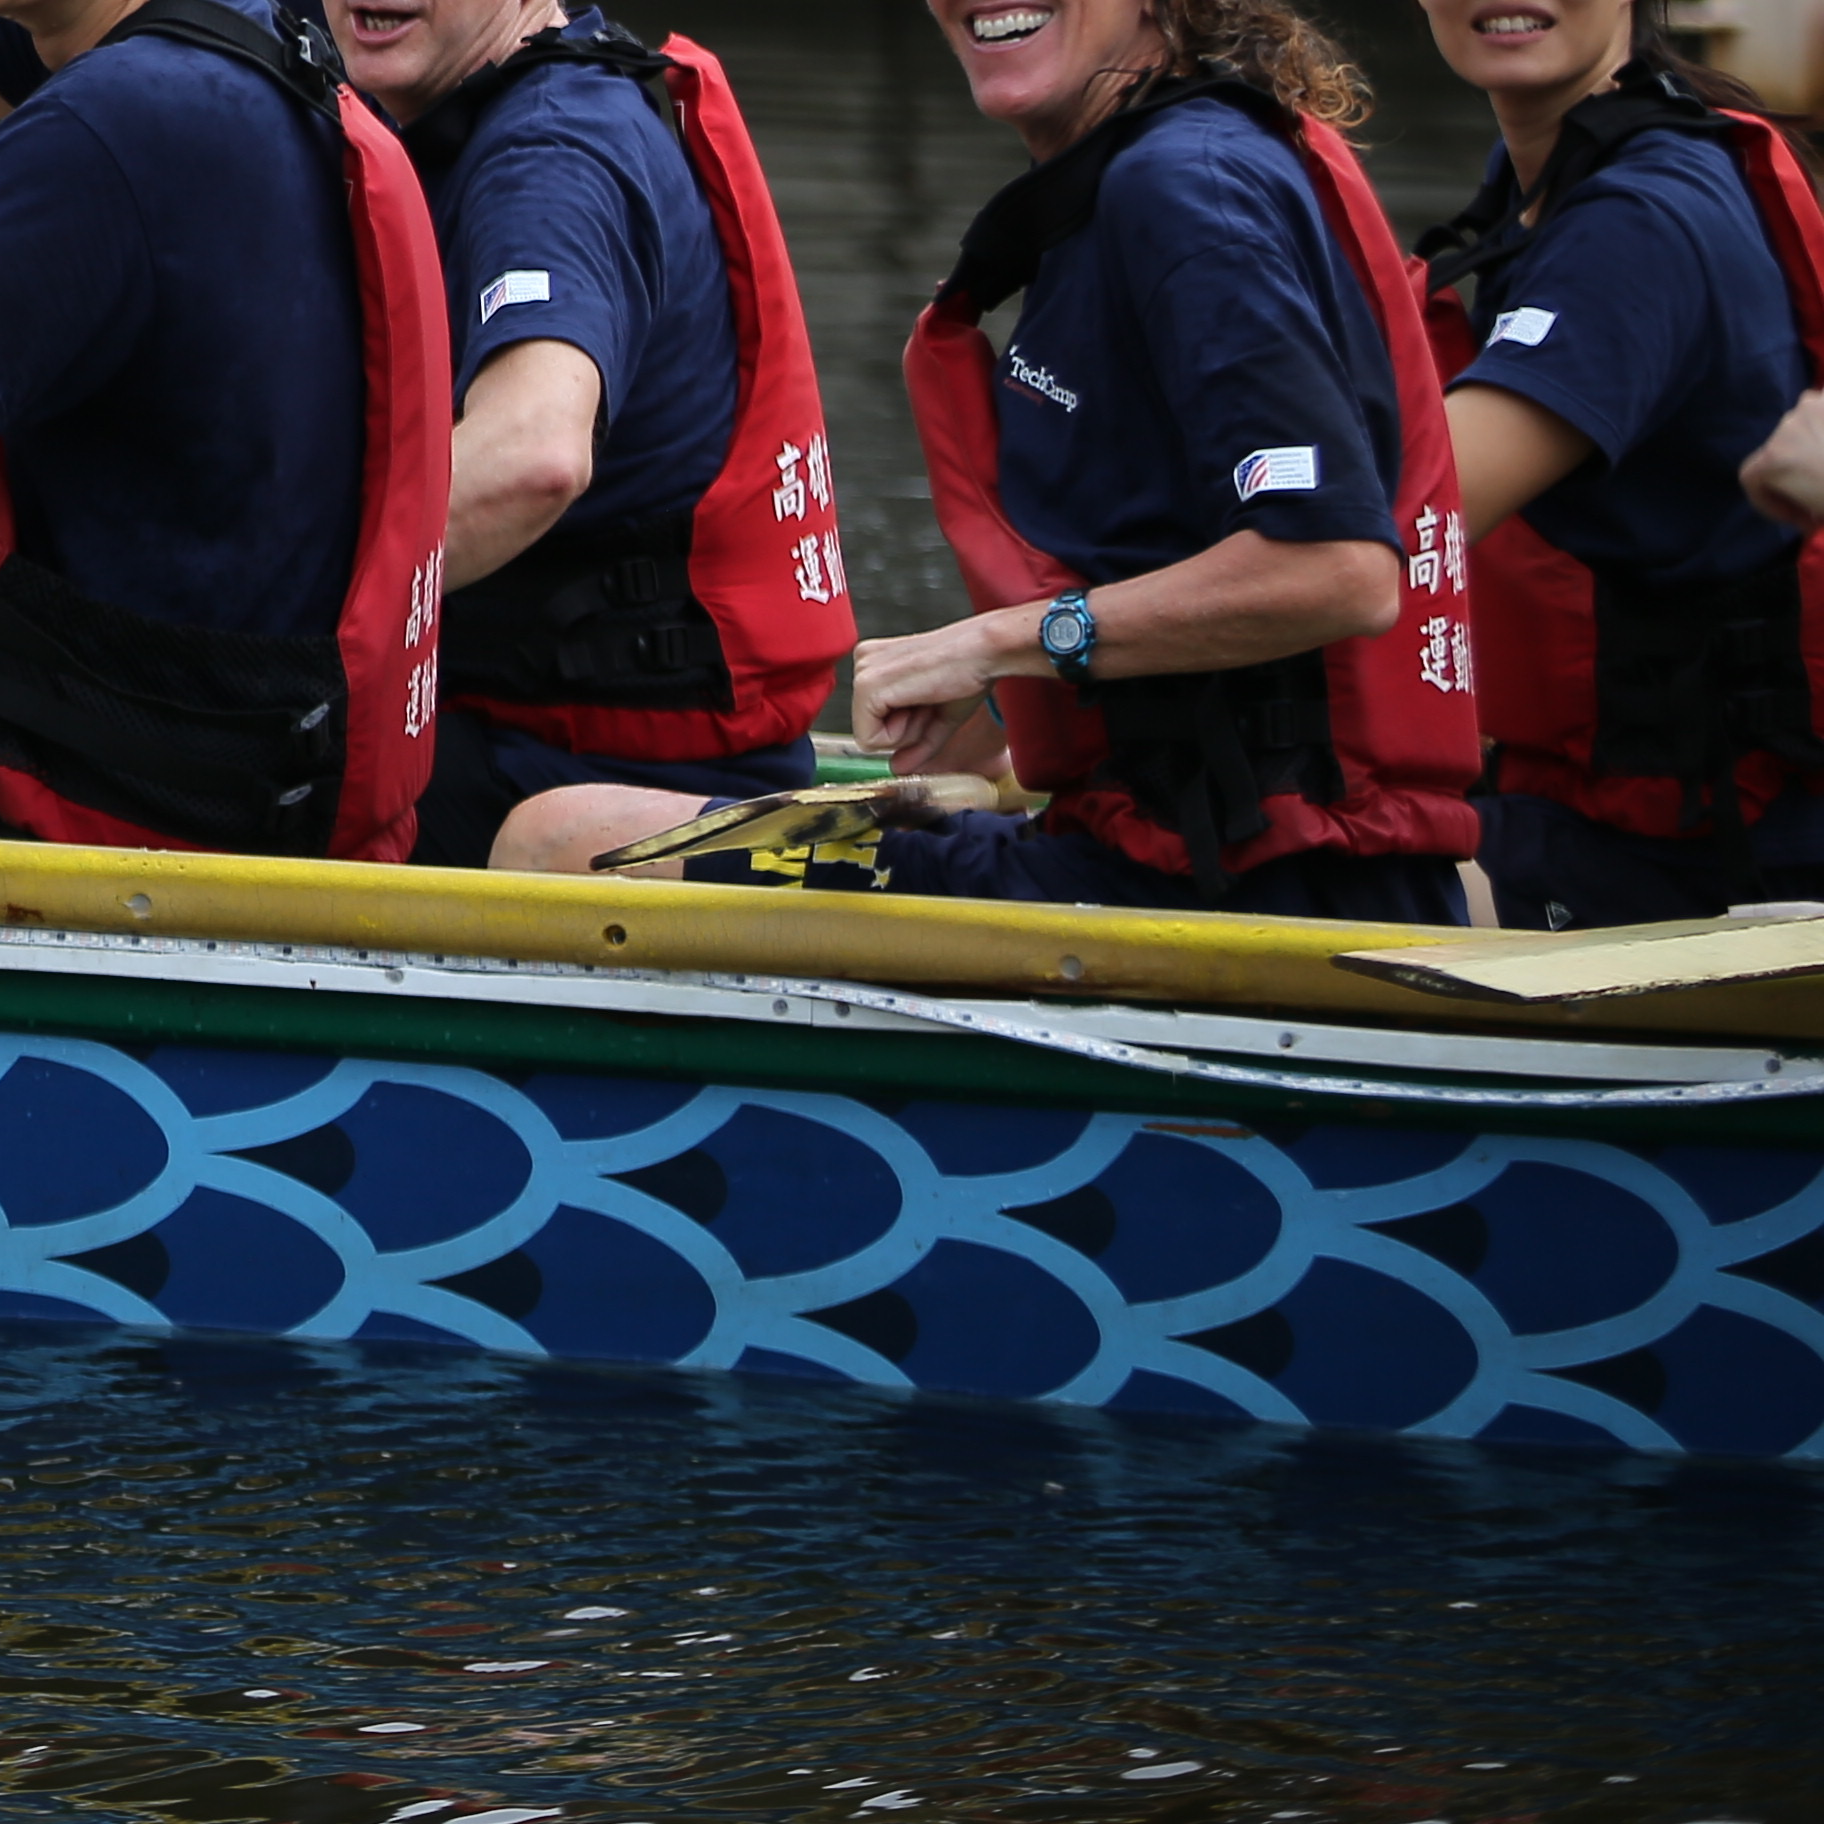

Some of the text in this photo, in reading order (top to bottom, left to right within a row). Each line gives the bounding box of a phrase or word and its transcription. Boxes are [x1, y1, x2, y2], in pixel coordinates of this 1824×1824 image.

[1009, 356, 1078, 413] TechCamp
[772, 431, 834, 522] 高雄
[790, 525, 848, 604] 運動
[1408, 504, 1467, 596] 高雄
[1419, 616, 1475, 697] 運動
